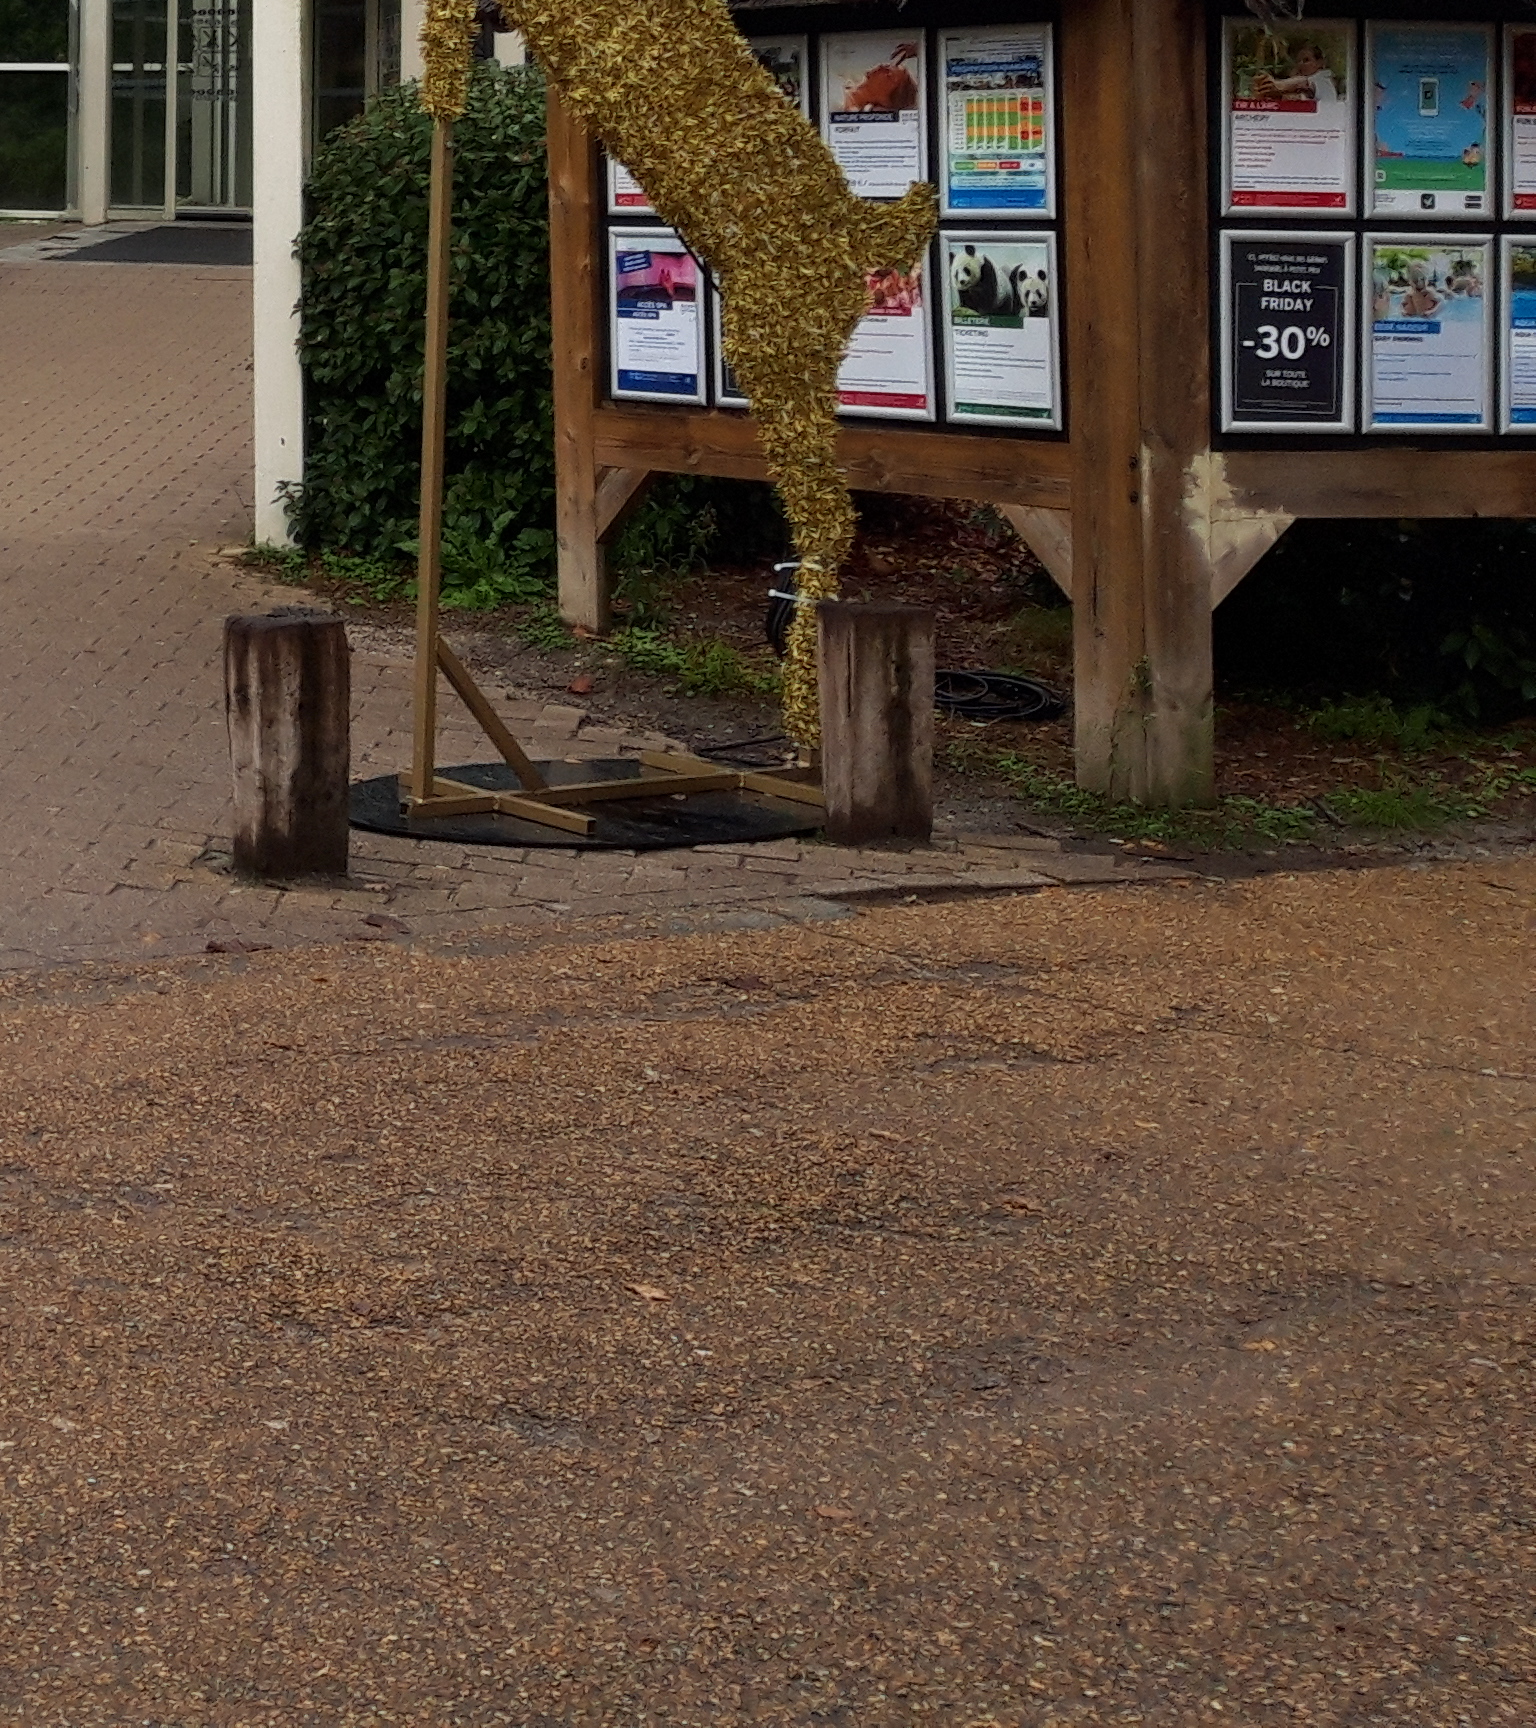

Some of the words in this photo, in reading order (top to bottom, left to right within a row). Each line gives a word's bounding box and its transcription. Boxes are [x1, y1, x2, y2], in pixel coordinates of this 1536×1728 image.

[1263, 278, 1312, 294] BLACK
[1260, 296, 1314, 312] FRIDAY
[1242, 325, 1330, 360] -30%
